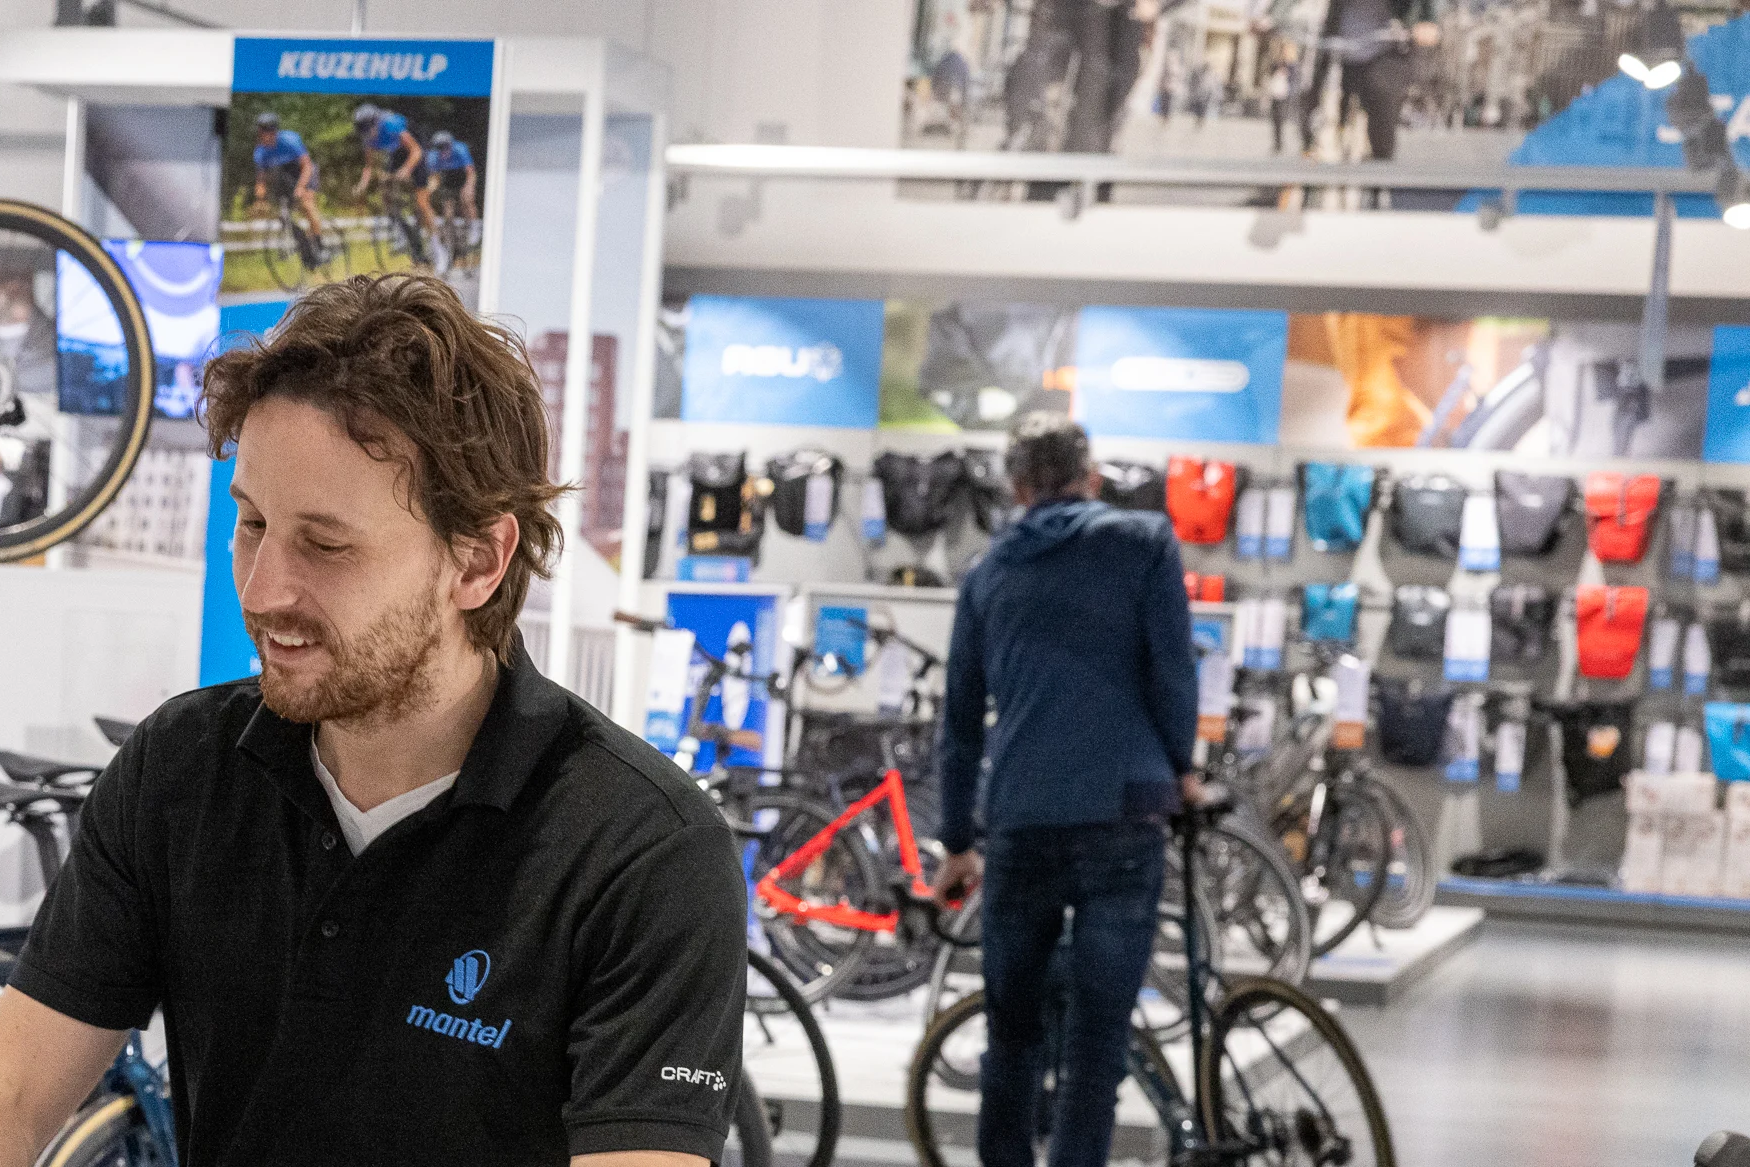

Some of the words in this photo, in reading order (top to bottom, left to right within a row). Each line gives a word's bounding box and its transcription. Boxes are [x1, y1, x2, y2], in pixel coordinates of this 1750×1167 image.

[277, 51, 448, 81] KEUZEHULP
[406, 1004, 512, 1049] mantel
[661, 1066, 716, 1086] CRAFT
